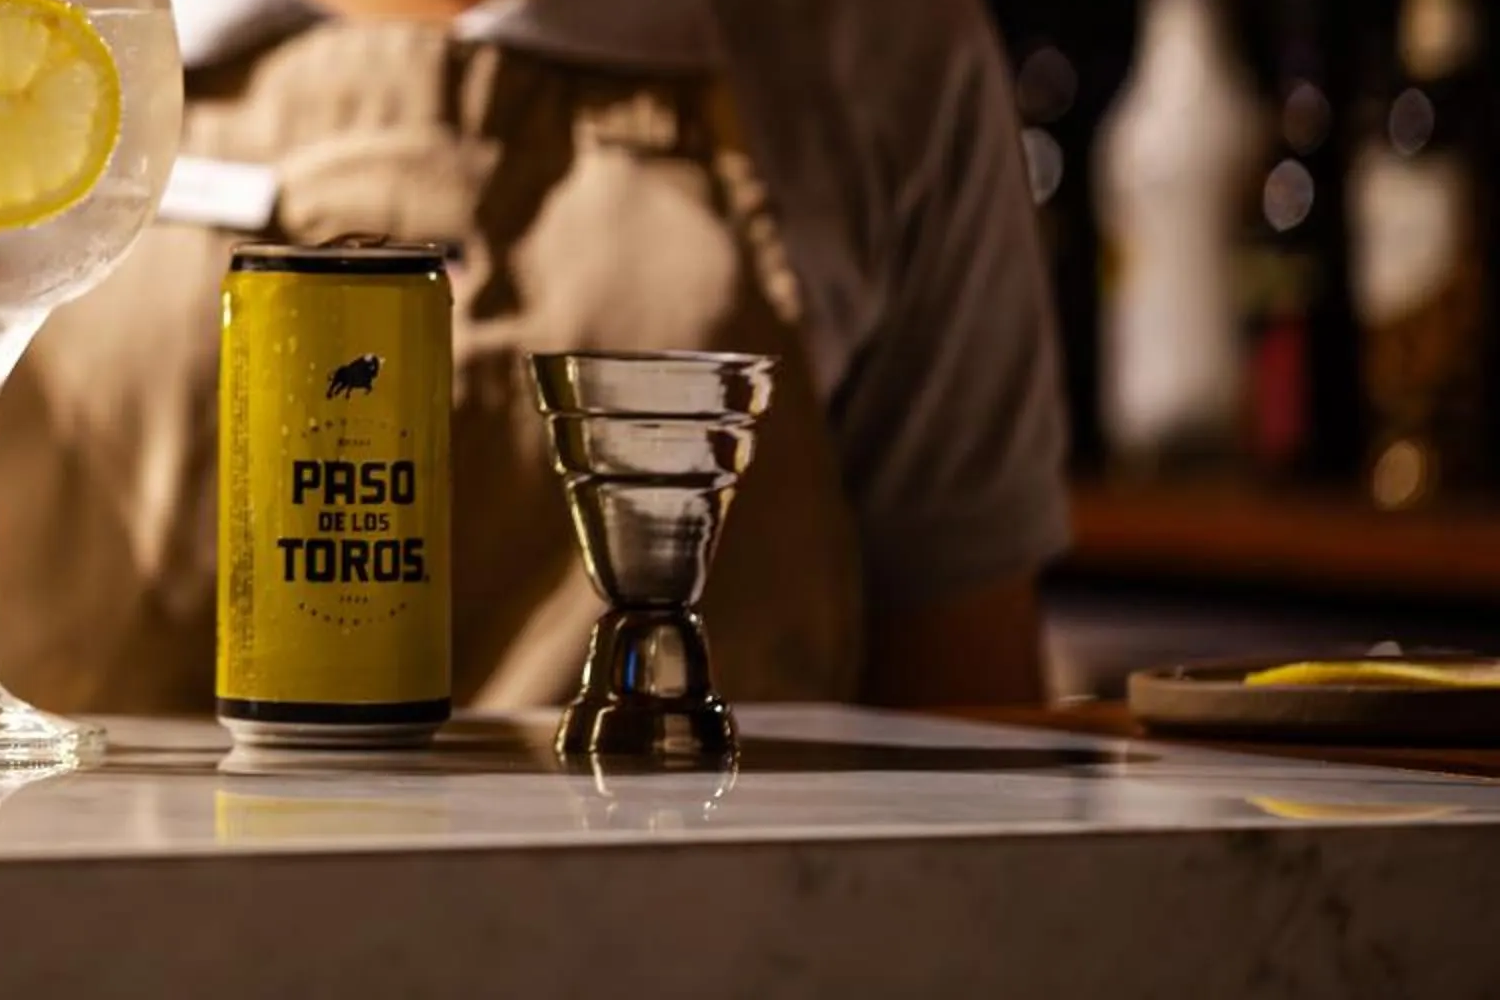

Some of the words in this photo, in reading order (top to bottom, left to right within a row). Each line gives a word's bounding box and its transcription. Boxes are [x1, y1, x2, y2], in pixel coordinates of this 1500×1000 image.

[292, 460, 415, 505] PASO
[319, 512, 345, 532] DE
[352, 512, 390, 532] LOS
[277, 538, 425, 582] TOROS
